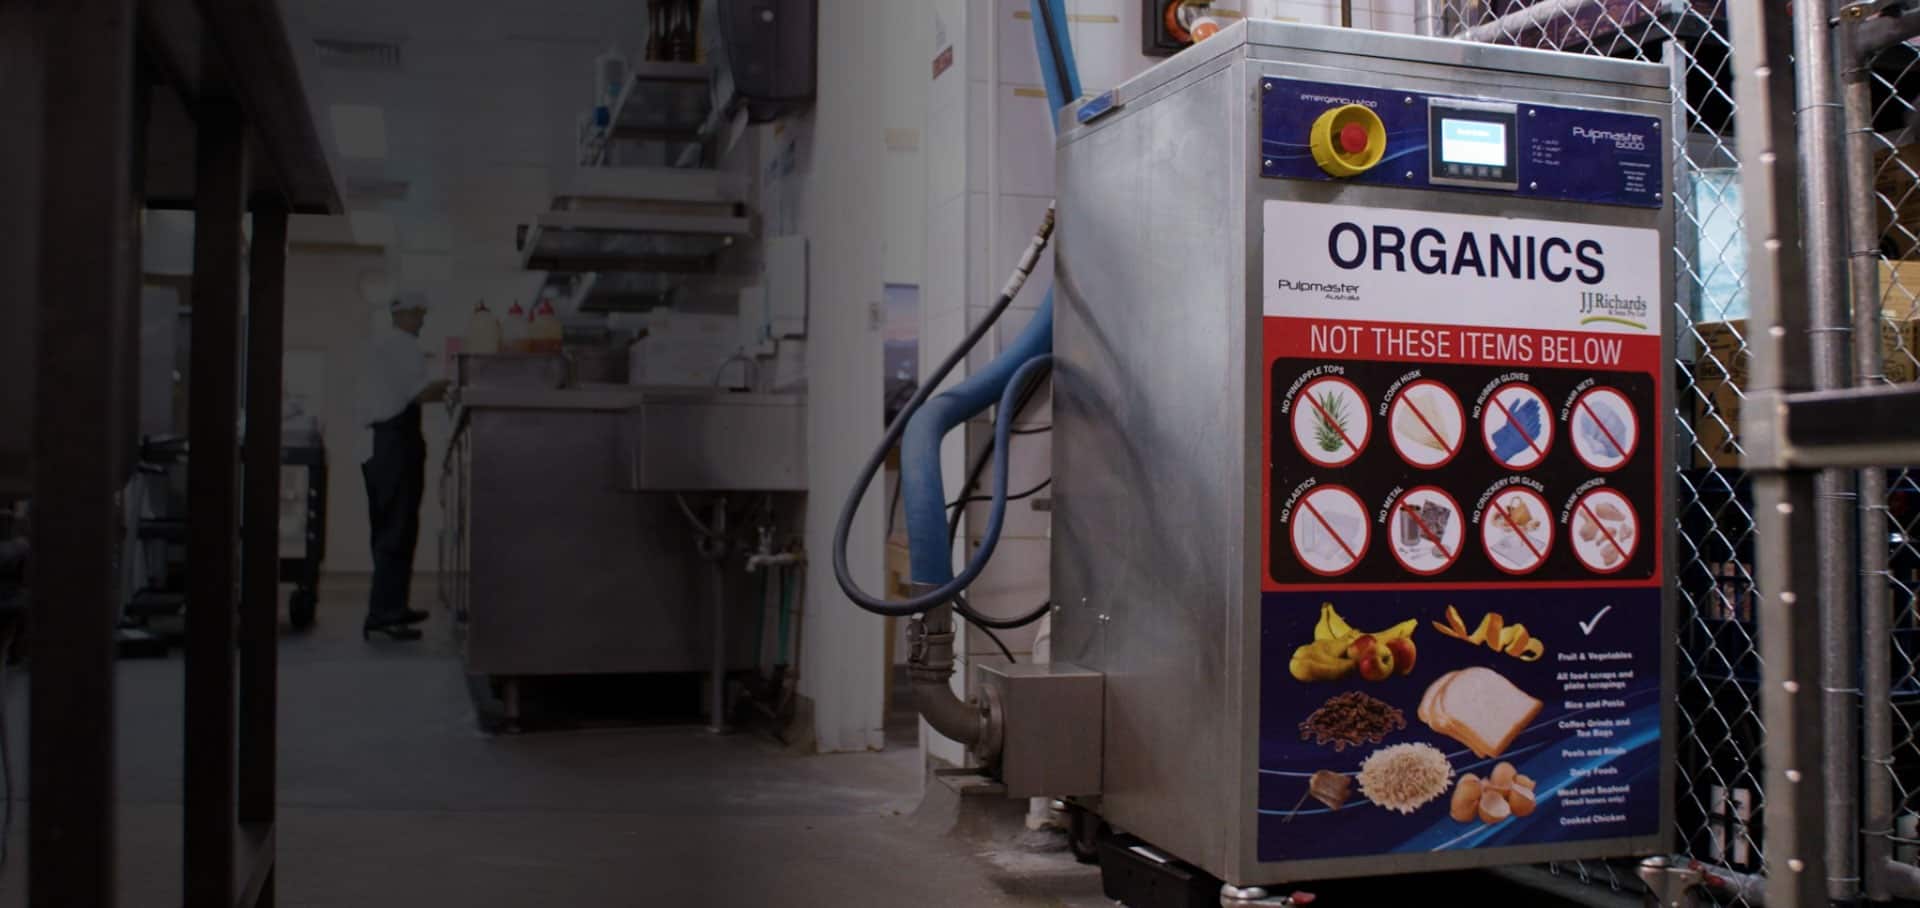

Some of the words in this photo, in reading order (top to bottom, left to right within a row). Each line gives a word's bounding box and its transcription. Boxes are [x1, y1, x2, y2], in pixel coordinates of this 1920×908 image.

[1573, 127, 1644, 144] Pulpmaster
[1328, 222, 1605, 285] ORGANICS
[1278, 279, 1360, 294] Pulpmaster
[1310, 324, 1363, 354] NOT
[1371, 327, 1451, 359] THESE
[1460, 331, 1533, 362] ITEMS
[1541, 336, 1623, 366] BELOW
[1281, 400, 1290, 414] NO
[1286, 366, 1322, 399] PINEAPPLE
[1323, 365, 1345, 376] TOPS
[1472, 405, 1481, 419] NO
[1501, 372, 1529, 382] GLOVES
[1379, 402, 1388, 416] NO
[1561, 408, 1569, 421] NO
[1280, 508, 1290, 523] NO
[1287, 476, 1316, 507] PLASTICS
[1379, 509, 1388, 523] NO
[1384, 486, 1404, 508] METAL
[1472, 510, 1481, 524] NO
[1509, 476, 1520, 484] OR
[1521, 476, 1544, 492] GLASS
[1561, 510, 1569, 524] NO
[1558, 652, 1577, 662] Fruit
[1588, 651, 1632, 661] Vegetables
[1556, 672, 1568, 681] All
[1570, 671, 1588, 681] food
[1618, 669, 1633, 679] and
[1585, 700, 1601, 709] and
[1558, 720, 1585, 729] Coffee
[1615, 717, 1630, 727] and
[1587, 748, 1602, 757] and
[1580, 787, 1596, 796] and
